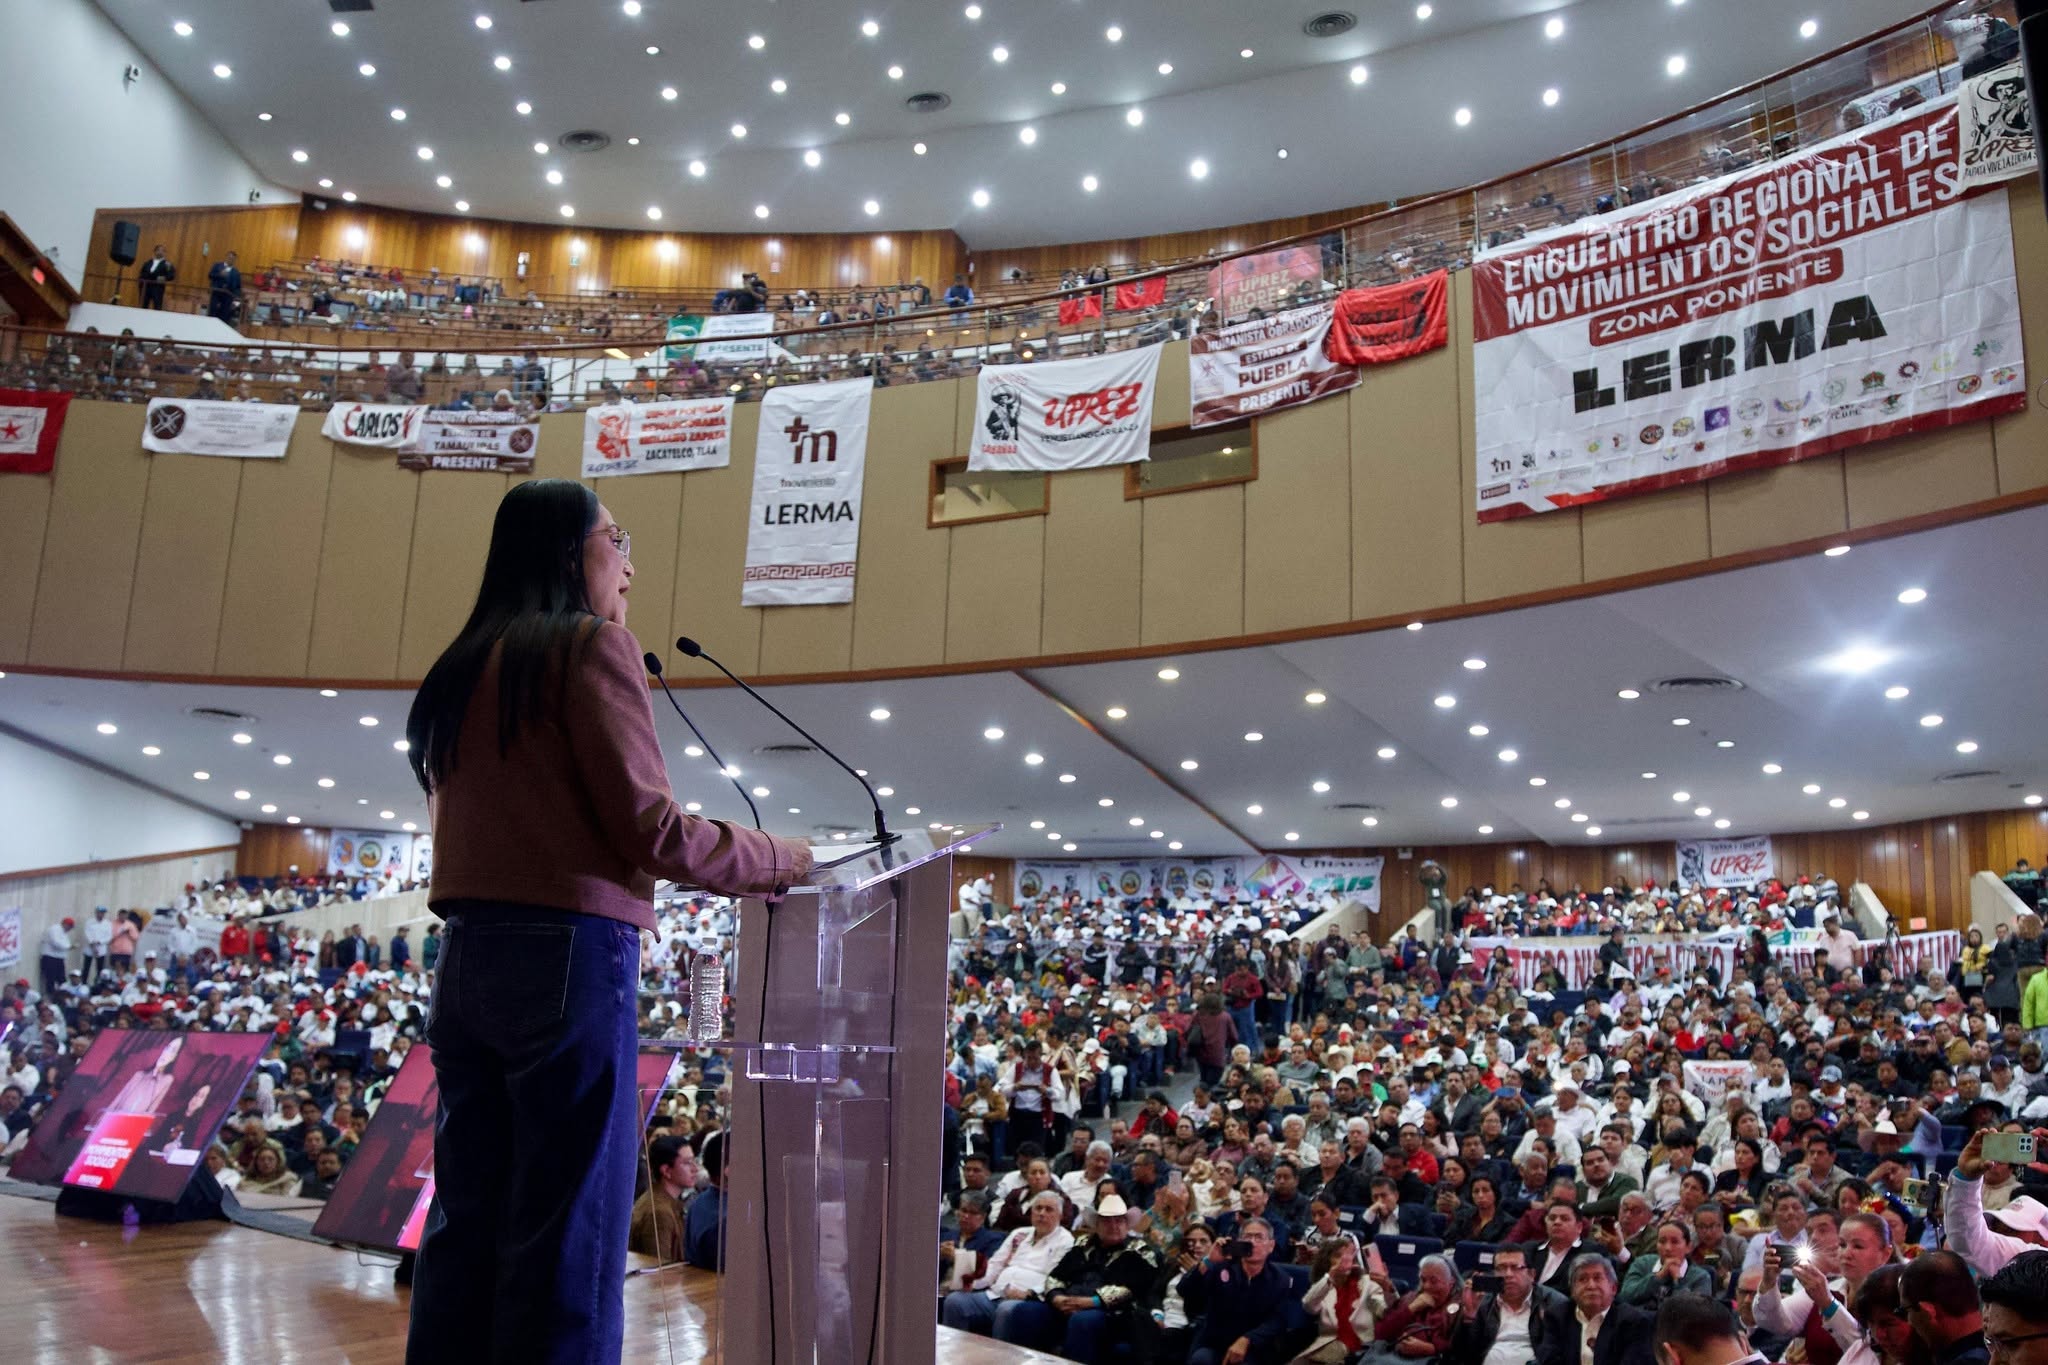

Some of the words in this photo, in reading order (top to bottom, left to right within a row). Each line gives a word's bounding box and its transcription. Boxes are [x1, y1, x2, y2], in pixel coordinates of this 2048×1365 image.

[1504, 205, 1699, 293] ENCUENTRO
[1710, 146, 1891, 234] REGIONAL
[1900, 123, 1953, 170] DE
[1507, 229, 1757, 329] MOVIMIENTOS
[1767, 162, 1961, 254] SOCIALES
[1238, 268, 1290, 293] UPREZ
[1599, 303, 1680, 338] ZONA
[1687, 257, 1832, 315] PONIENTE
[1208, 329, 1266, 351] HUMANISTA
[1245, 346, 1283, 362] ESTADO
[1573, 294, 1888, 414] LERMA
[1239, 356, 1309, 387] PUEBLA
[1043, 382, 1144, 429] UPREZ
[1239, 380, 1311, 411] PRESENTE
[344, 404, 402, 438] CARLOS
[432, 456, 498, 469] PRESENTE
[764, 501, 854, 525] LERMA
[1711, 851, 1767, 876] UPREZ
